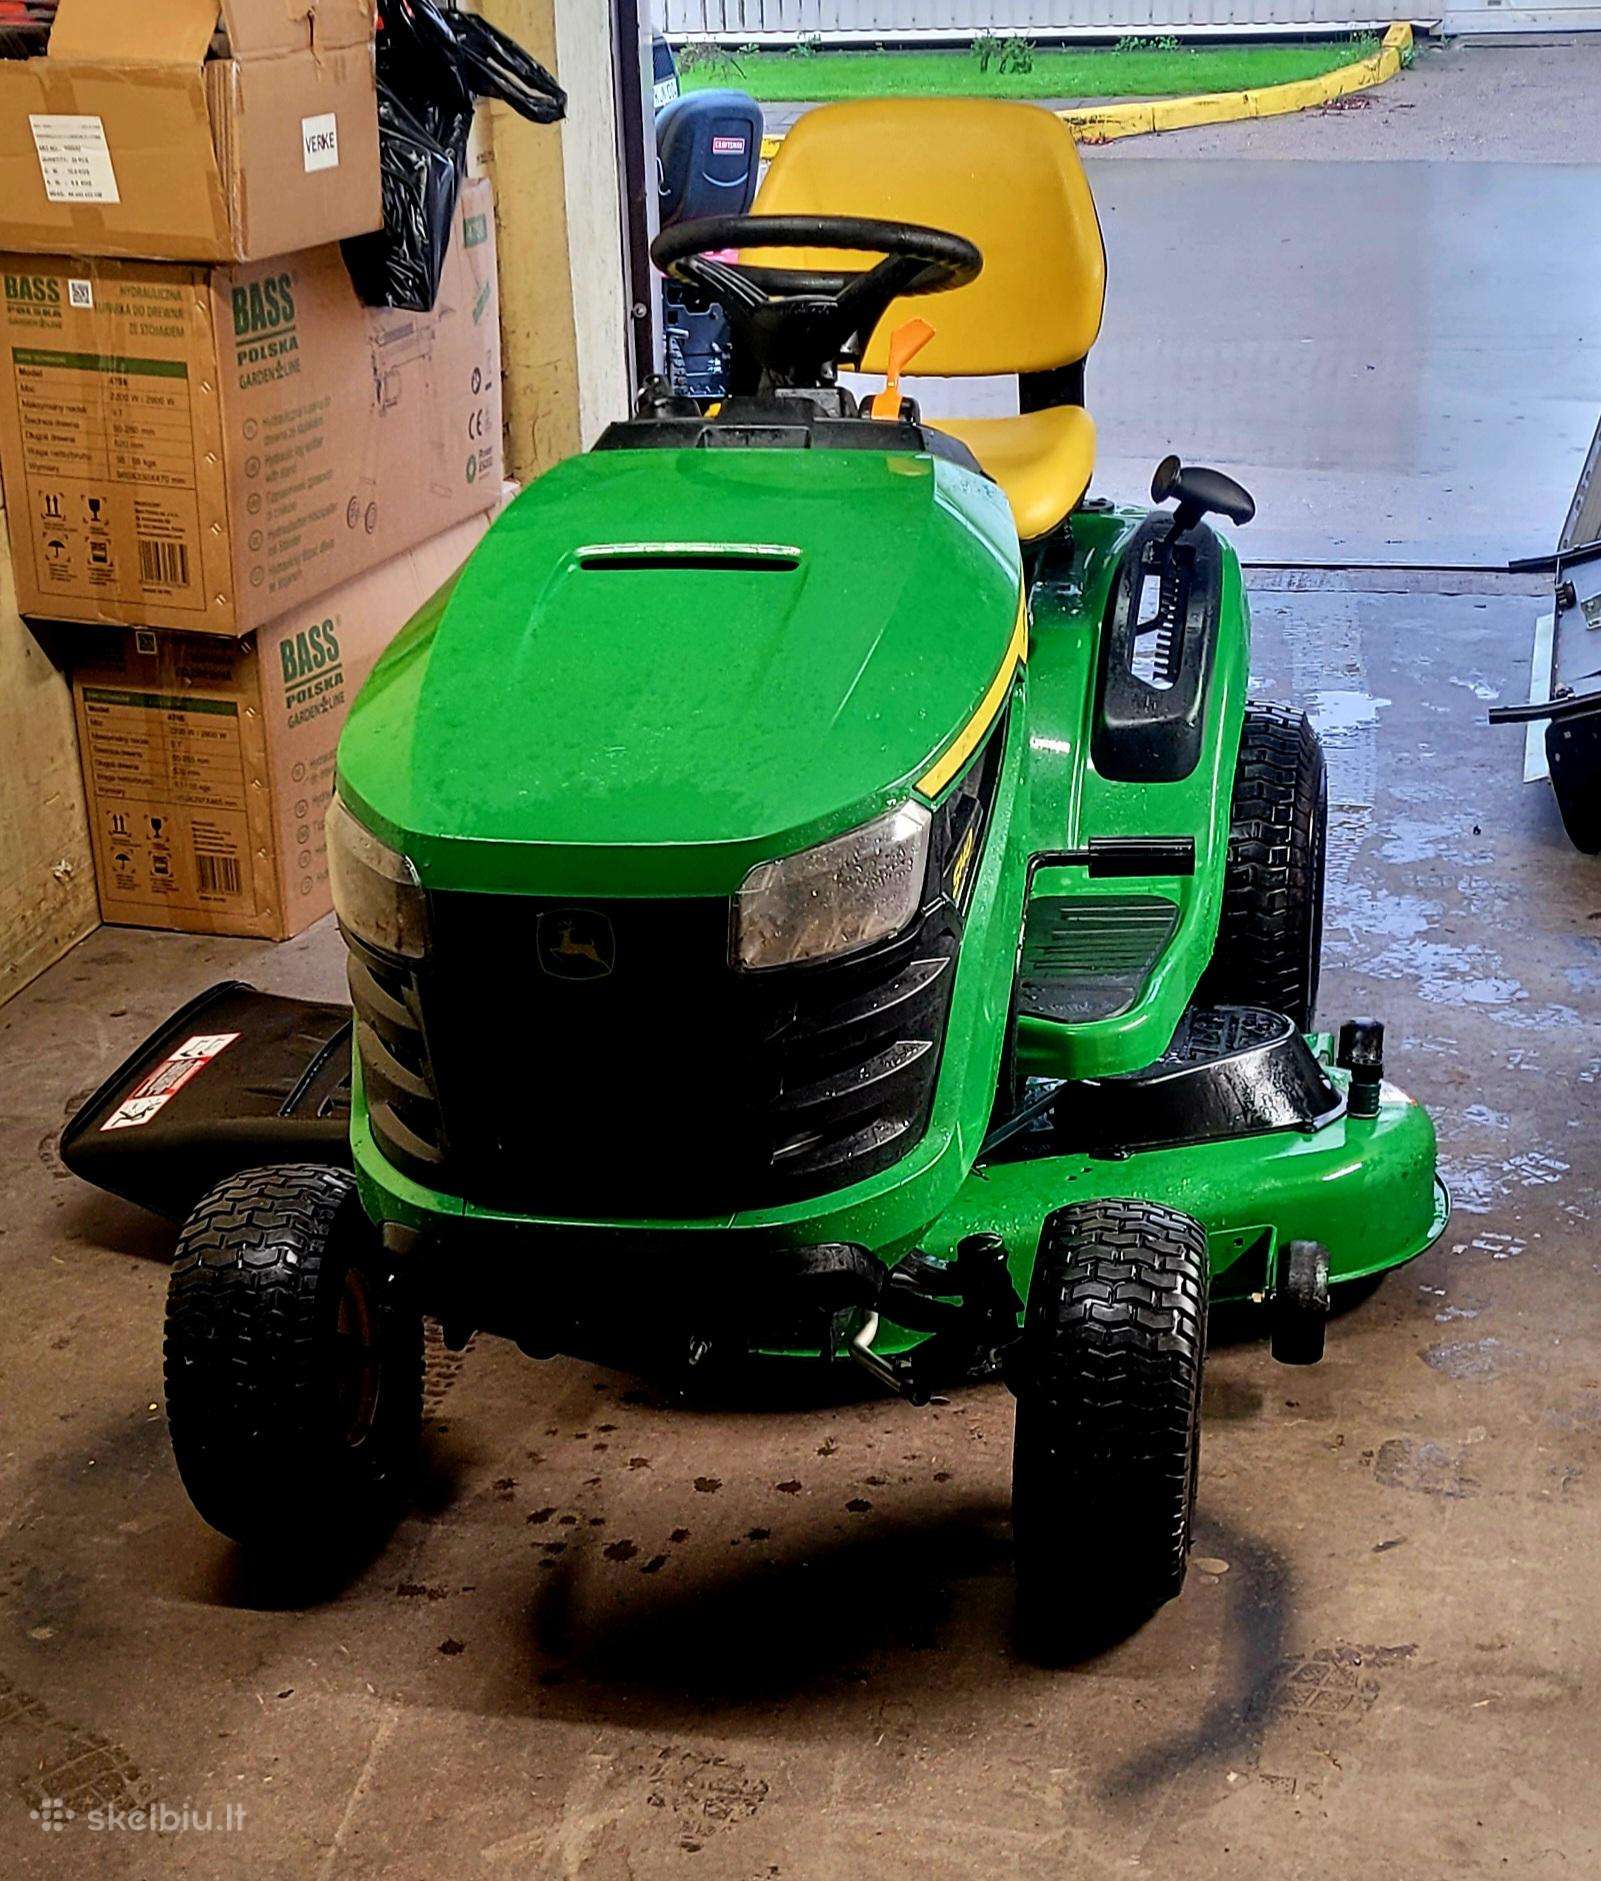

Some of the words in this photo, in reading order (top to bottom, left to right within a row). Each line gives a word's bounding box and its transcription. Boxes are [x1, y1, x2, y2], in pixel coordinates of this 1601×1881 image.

[305, 132, 335, 154] VERKE
[715, 140, 743, 149] CRAFTSMAN
[4, 275, 60, 302] BASS
[232, 273, 296, 335] BASS
[237, 336, 299, 366] POLSKA
[280, 619, 340, 683] BASS
[286, 672, 344, 709] POLSKA
